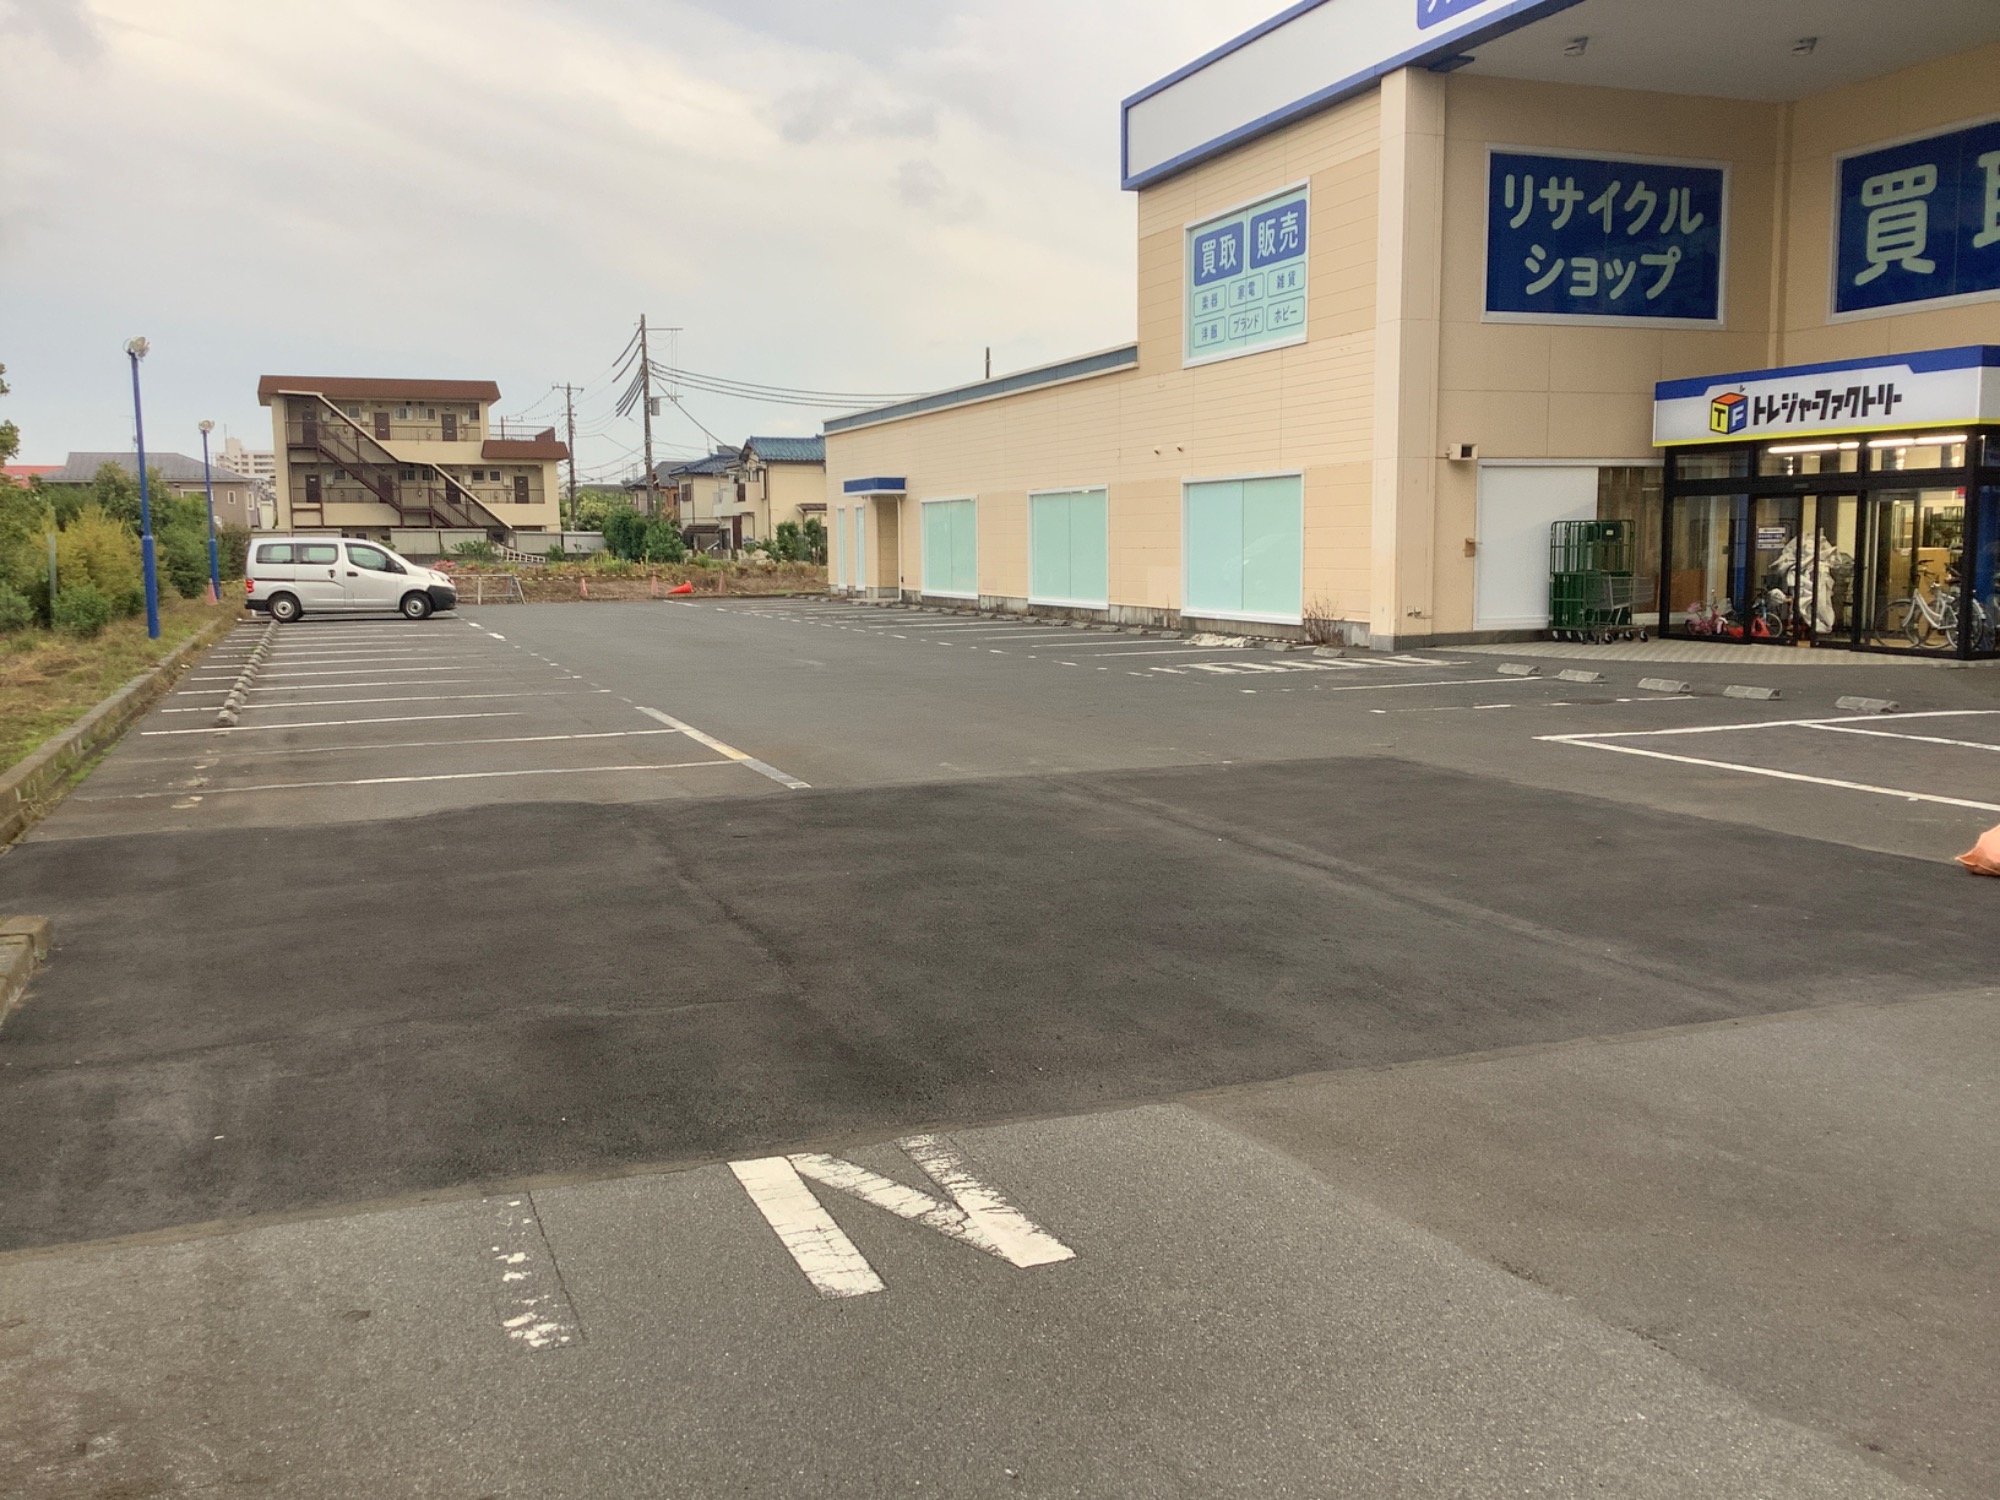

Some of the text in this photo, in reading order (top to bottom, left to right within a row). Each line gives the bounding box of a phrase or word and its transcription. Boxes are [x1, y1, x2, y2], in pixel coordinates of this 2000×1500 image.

[1504, 173, 1704, 236] リサイクル
[1201, 211, 1298, 278] 買取 販売
[1525, 243, 1682, 300] ショップ
[1233, 313, 1260, 334] ブランド
[1274, 305, 1298, 324] ホビー
[1753, 382, 1902, 426] トレジャーファクトリー
